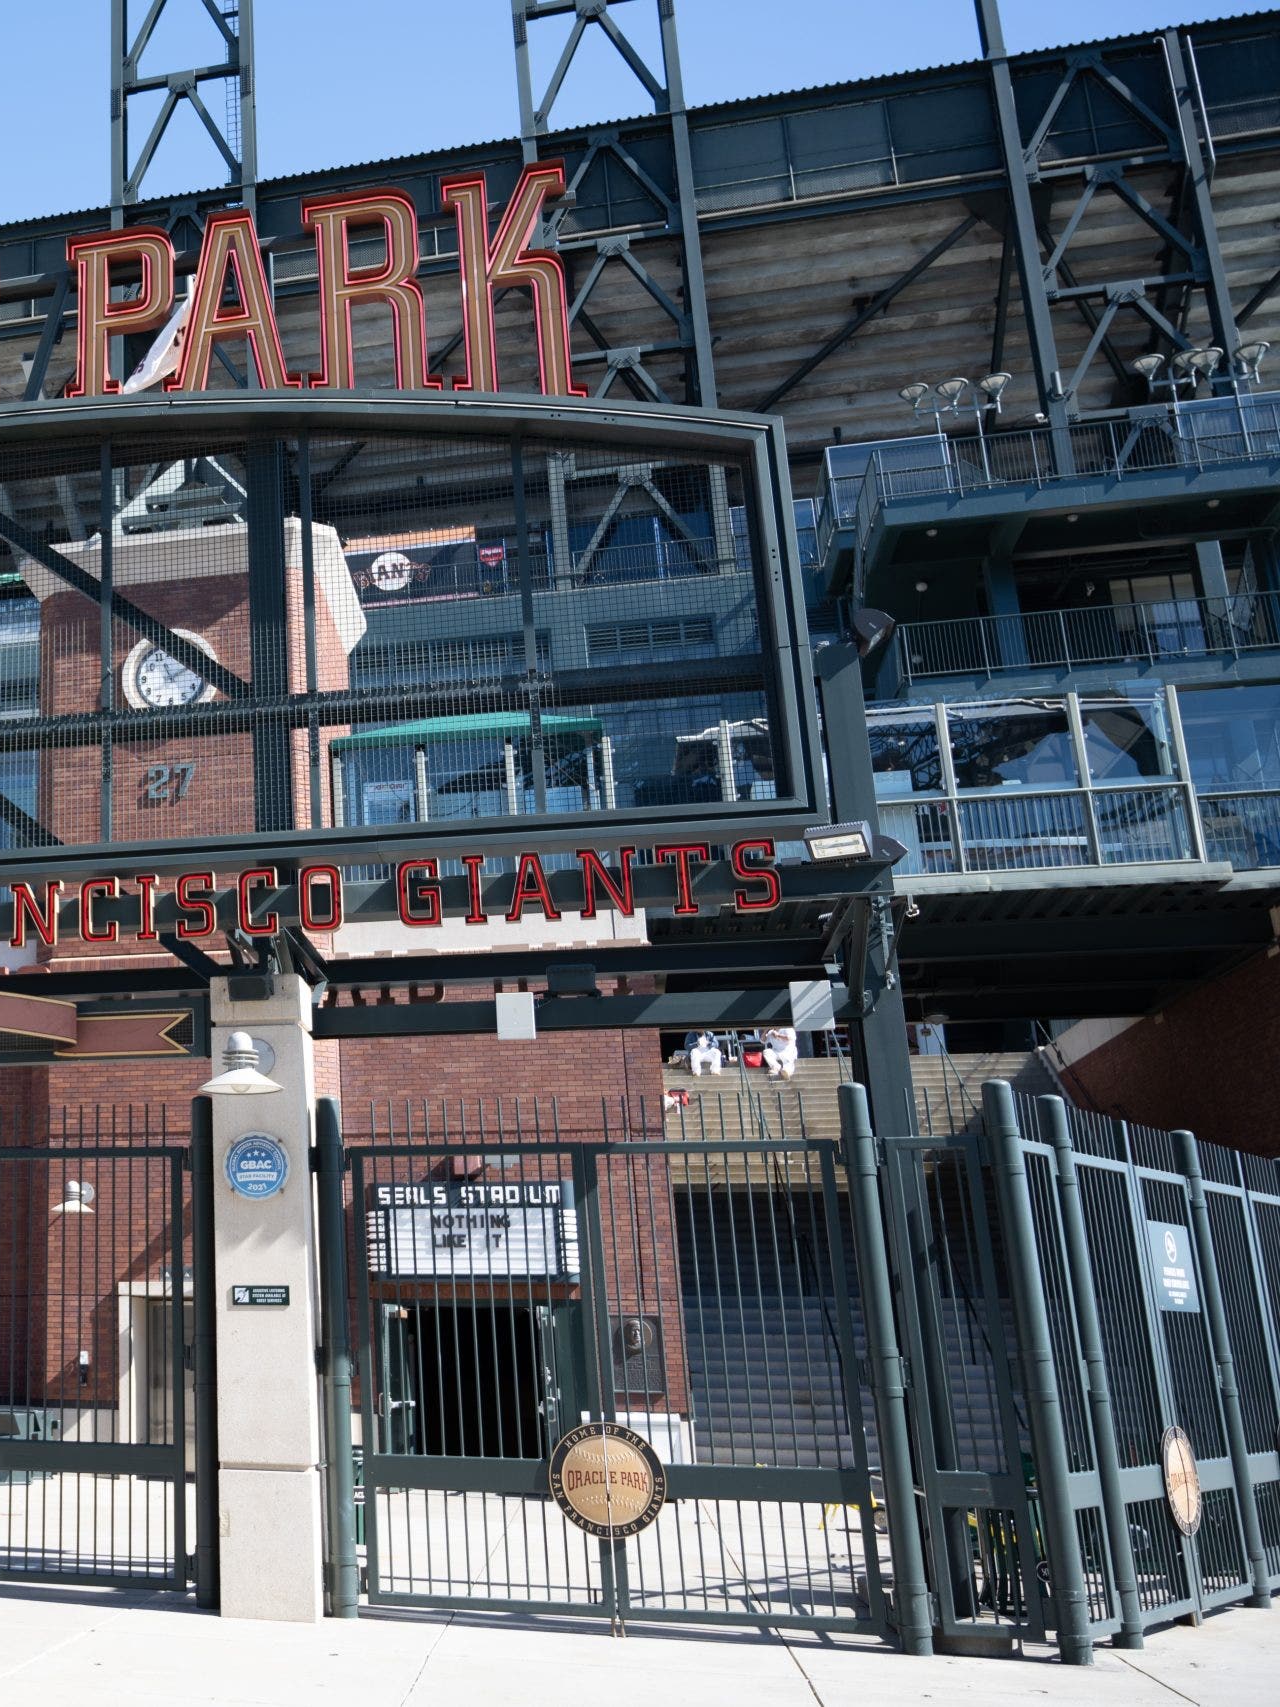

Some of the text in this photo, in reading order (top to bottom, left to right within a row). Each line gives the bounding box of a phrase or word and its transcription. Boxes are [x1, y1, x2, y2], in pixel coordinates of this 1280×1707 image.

[65, 158, 588, 399] PARK
[148, 762, 196, 798] 27
[395, 837, 781, 929] GIANTS
[240, 1159, 272, 1170] GBAC
[247, 1182, 267, 1191] 2021
[378, 1185, 561, 1205] SEALS STADIUM
[431, 1214, 511, 1229] NOTHING
[433, 1234, 467, 1248] LIKE
[564, 1426, 646, 1450] HOME OF THE
[567, 1470, 649, 1494] ORACLE PARK
[552, 1473, 663, 1536] SAN FRANCISCO GIANTS
